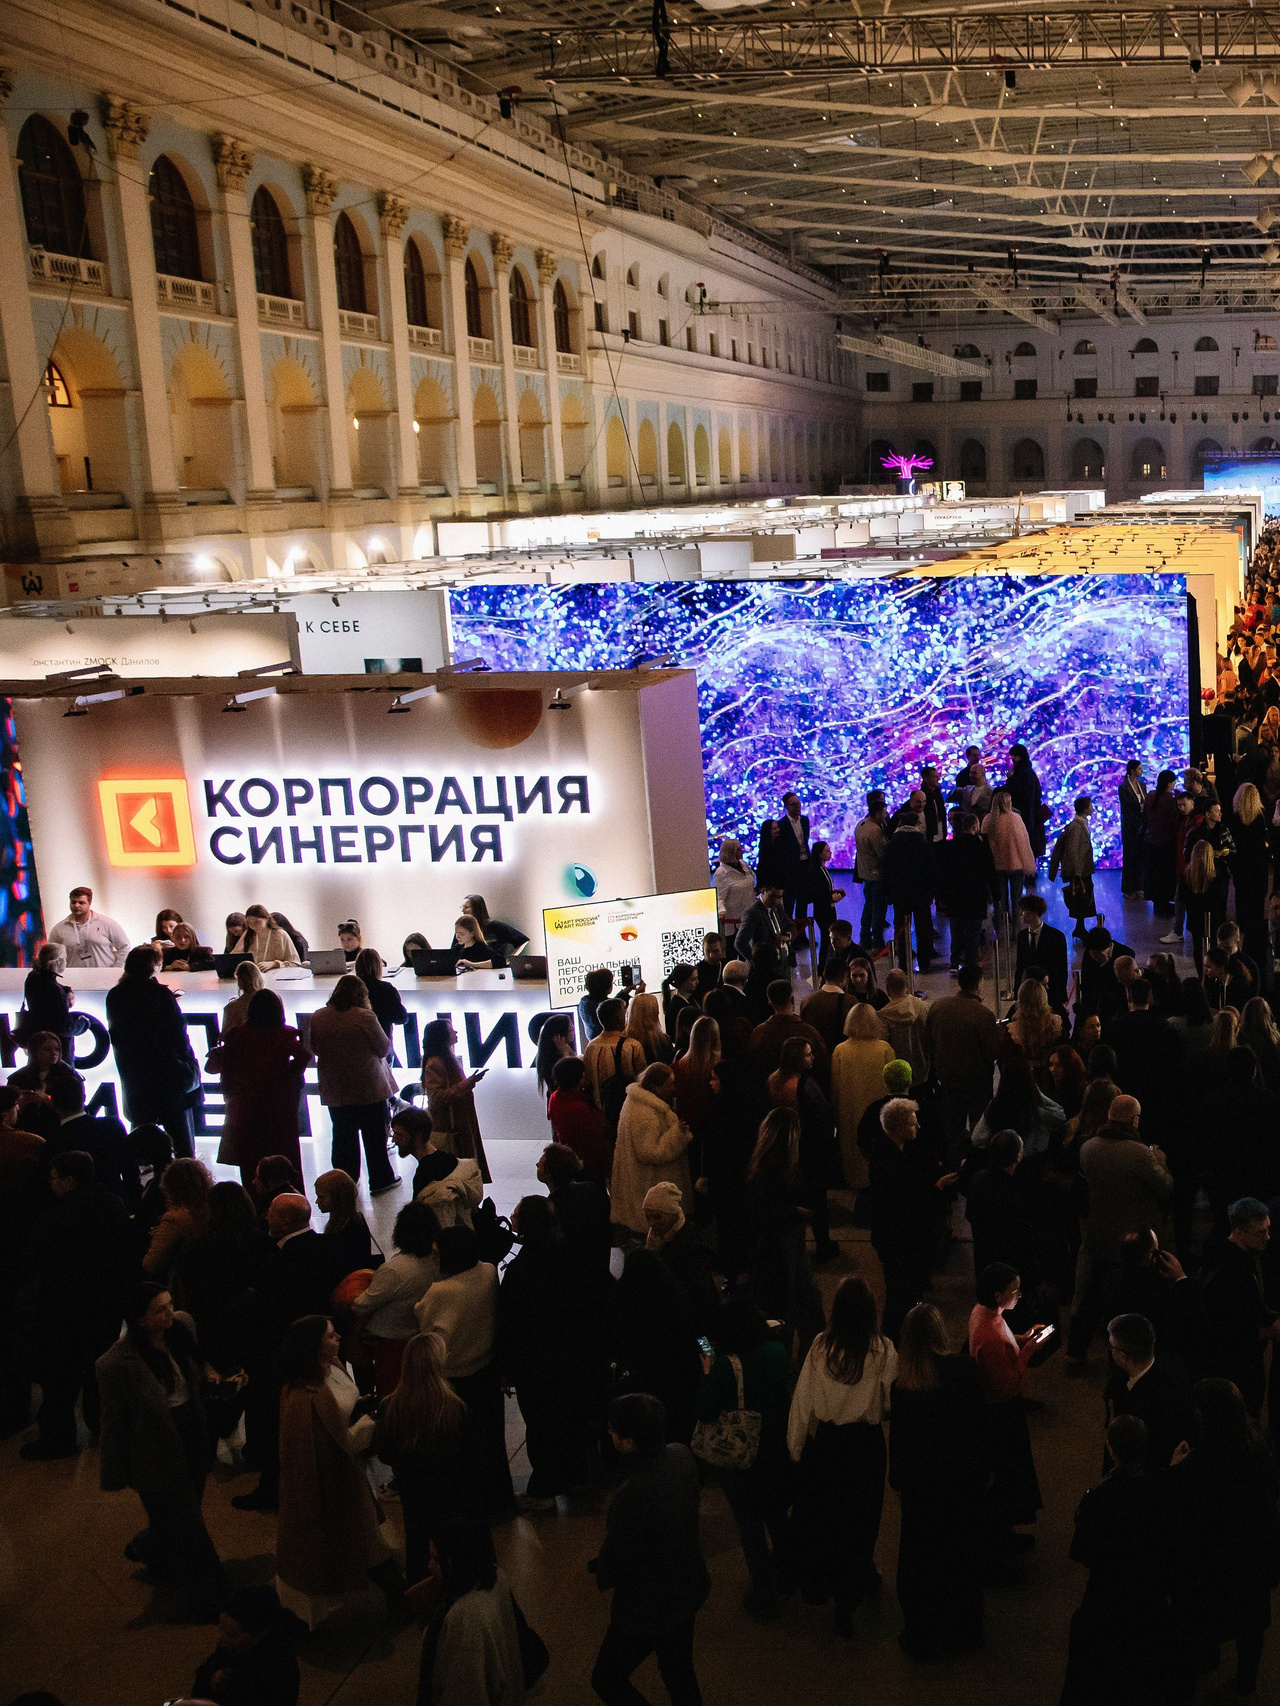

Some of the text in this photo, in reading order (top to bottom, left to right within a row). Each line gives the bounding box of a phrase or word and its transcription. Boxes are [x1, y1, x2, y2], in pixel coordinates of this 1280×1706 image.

[305, 621, 315, 633] К
[319, 620, 360, 633] СЕБЕ
[121, 657, 160, 667] Данилов
[203, 775, 590, 822] КОРПОРАЦИЯ
[209, 824, 503, 865] СИНЕРГИЯ
[557, 956, 582, 967] ВАШ
[559, 985, 574, 996] ПО
